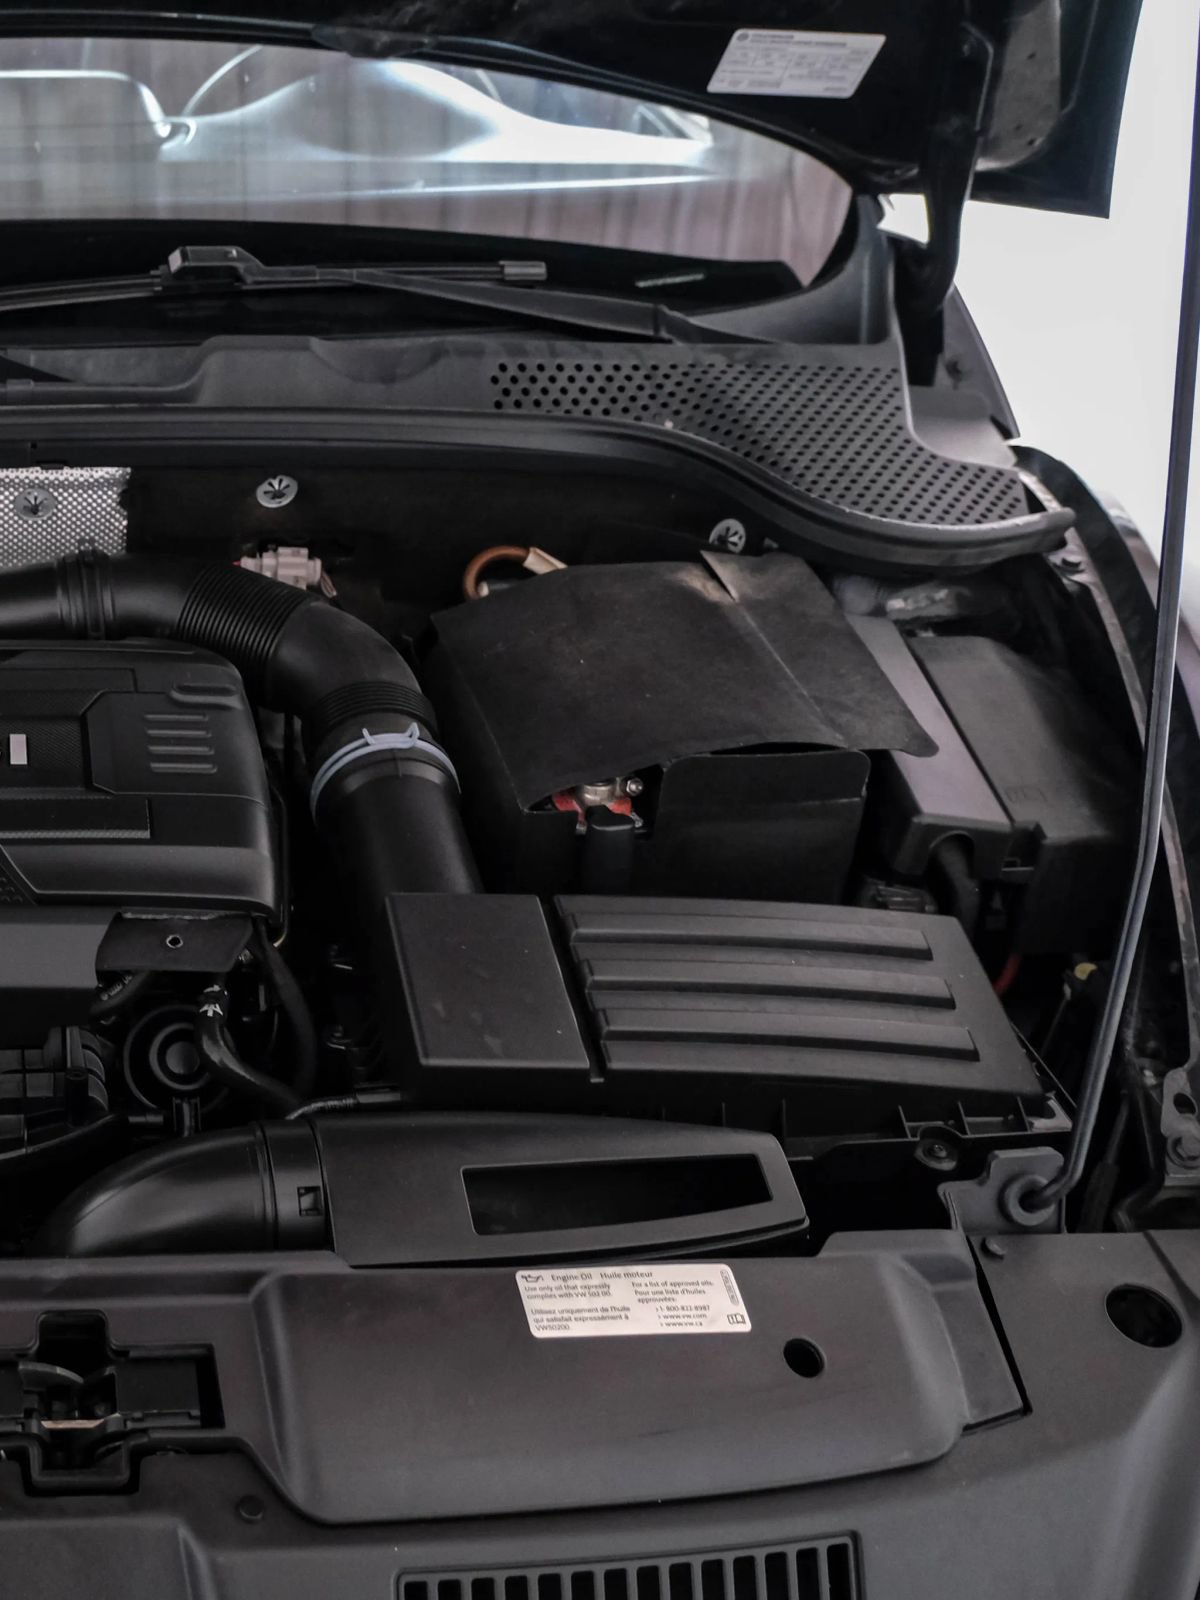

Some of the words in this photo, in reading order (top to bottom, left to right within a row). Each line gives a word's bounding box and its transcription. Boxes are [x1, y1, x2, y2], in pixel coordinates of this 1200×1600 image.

[551, 1274, 578, 1282] Engine
[579, 1282, 610, 1290] expressly
[669, 1280, 700, 1288] approved
[557, 1307, 599, 1315] uniquement
[574, 1314, 623, 1322] expressément
